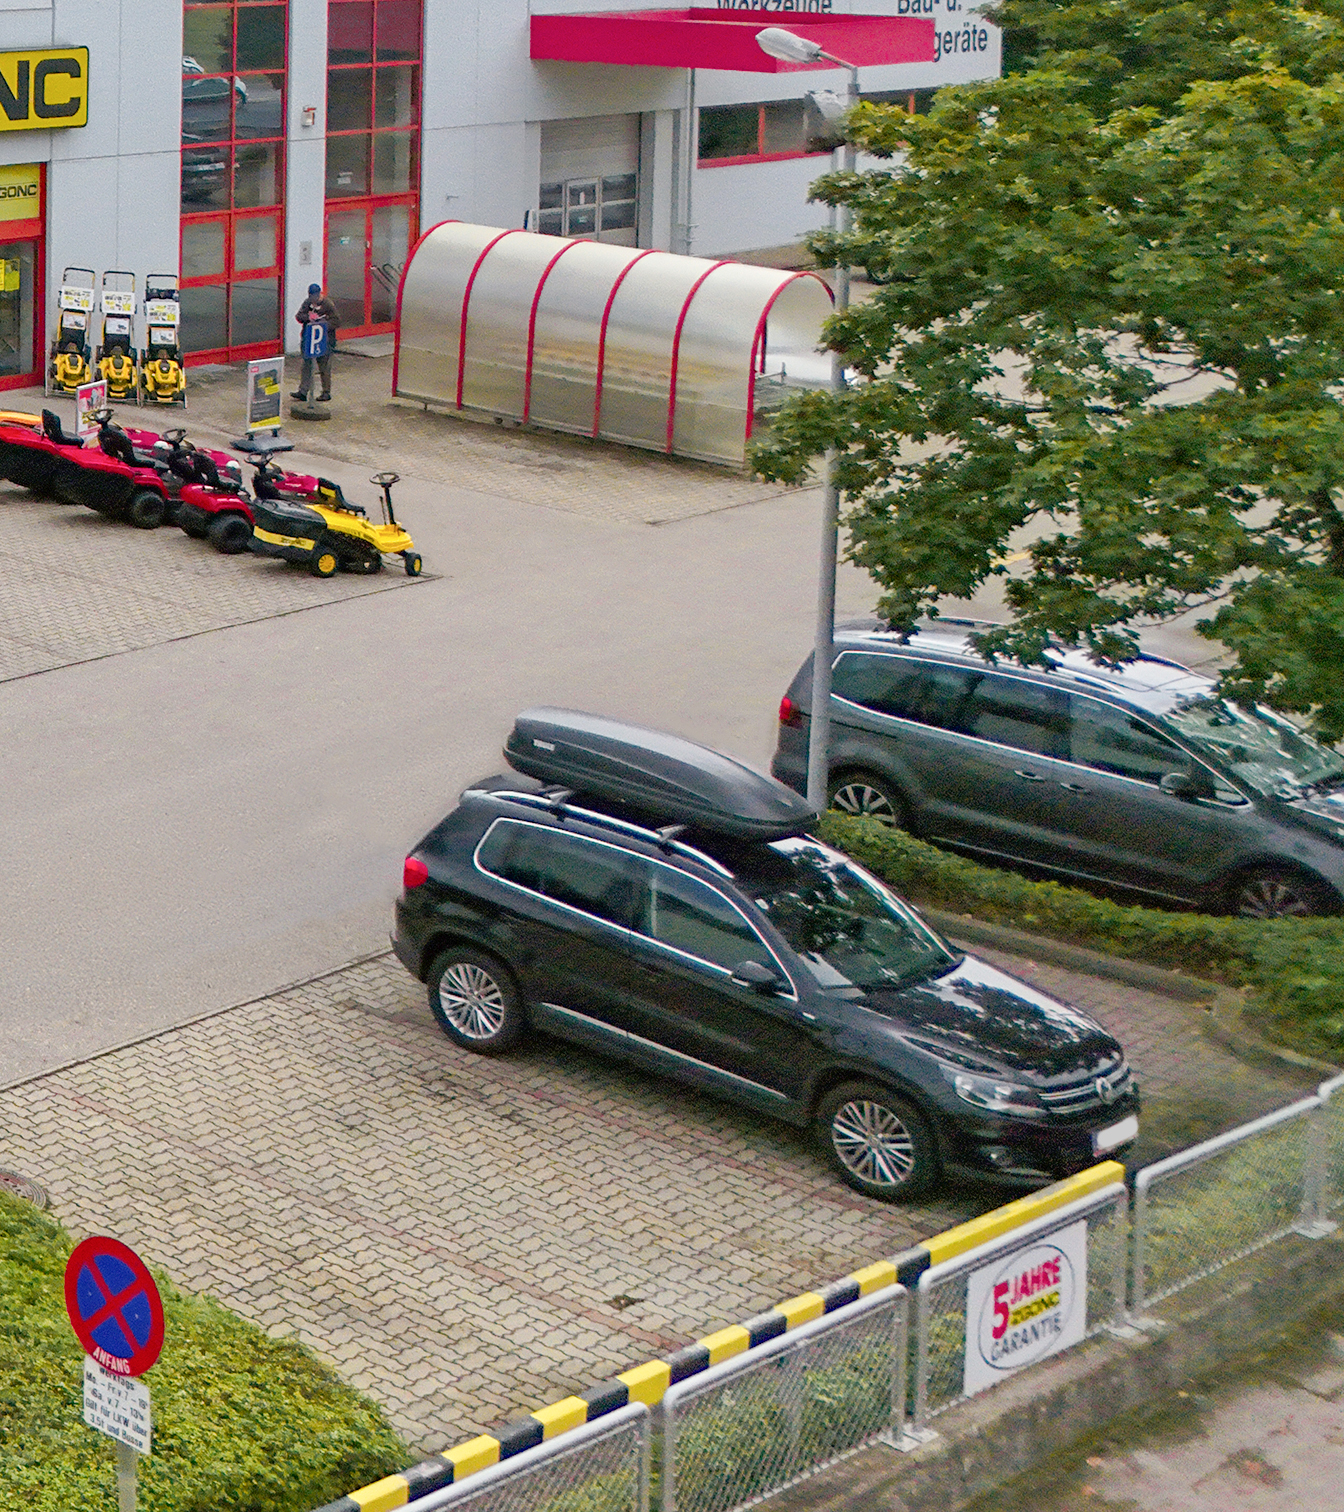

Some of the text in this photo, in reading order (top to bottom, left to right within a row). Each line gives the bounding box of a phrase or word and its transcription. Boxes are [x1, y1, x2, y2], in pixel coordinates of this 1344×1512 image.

[310, 324, 324, 354] P
[992, 1255, 1061, 1339] 5 JAHRE
[991, 1311, 1061, 1361] GARANTIE
[93, 1346, 130, 1374] ANFANG
